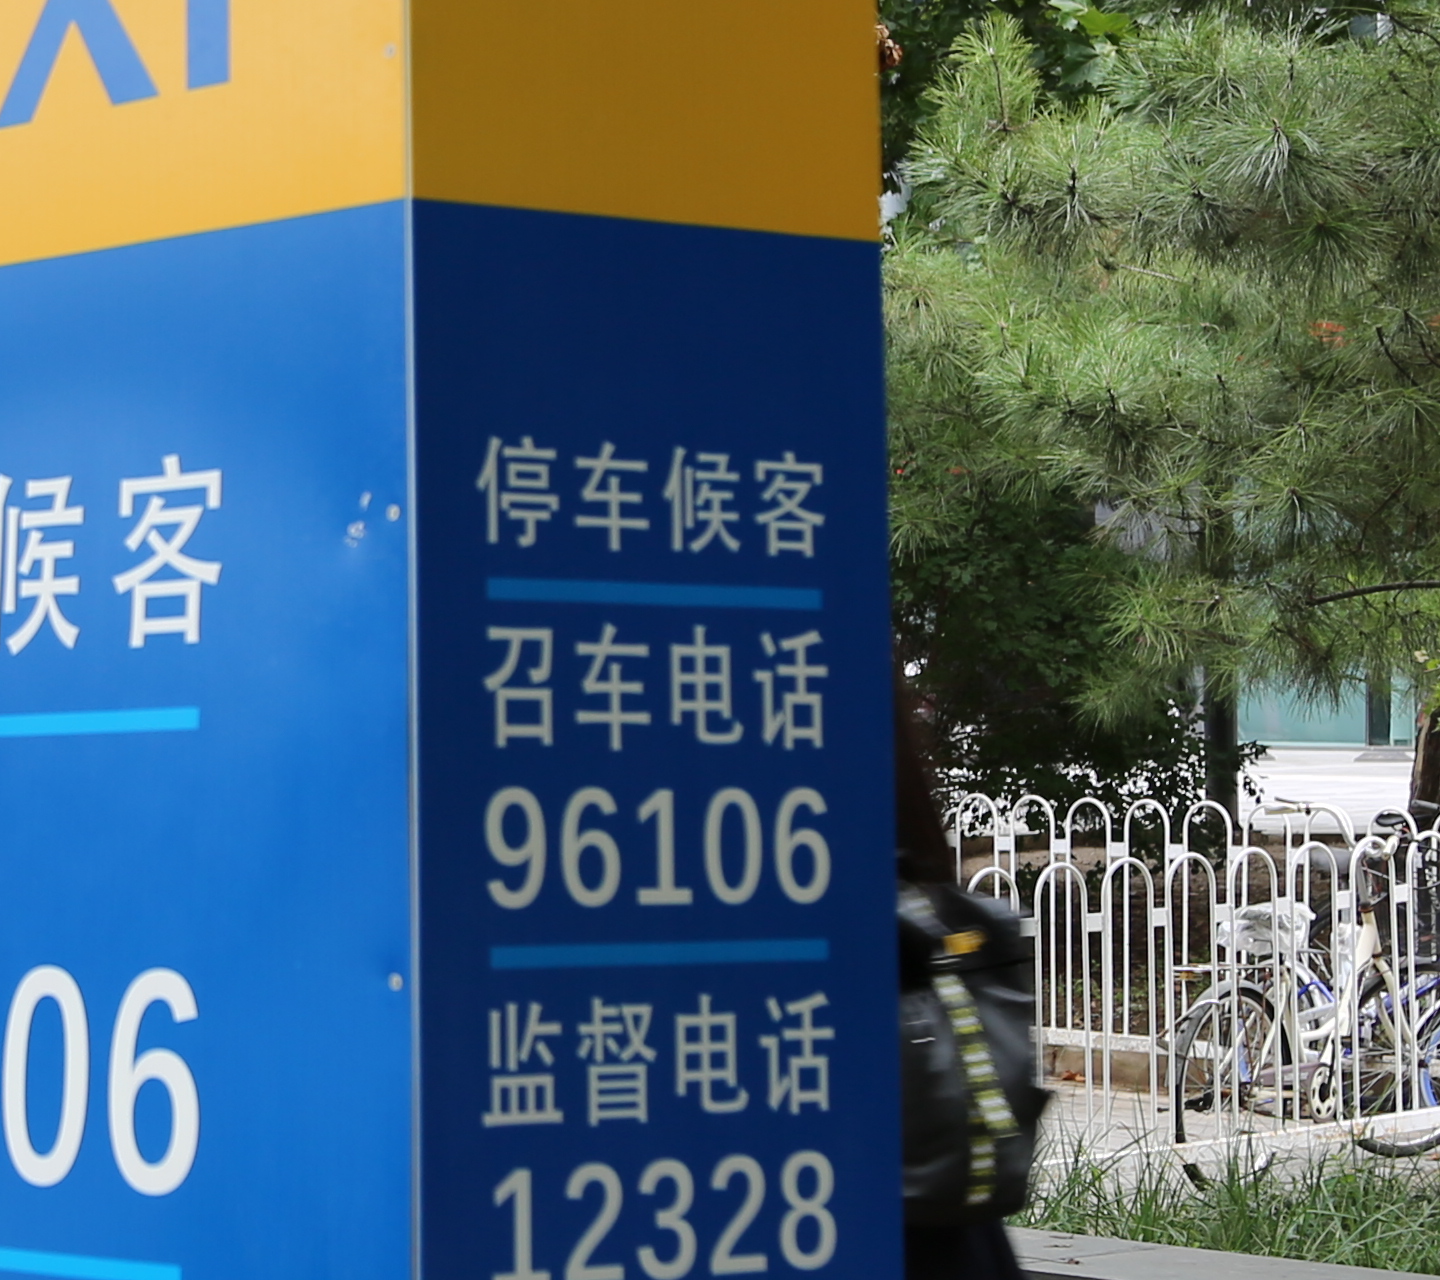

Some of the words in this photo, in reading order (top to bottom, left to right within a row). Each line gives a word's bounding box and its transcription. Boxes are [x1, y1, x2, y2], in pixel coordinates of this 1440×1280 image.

[475, 435, 826, 559] 停车候客
[483, 622, 829, 753] 召车电话
[483, 785, 832, 911] 96106
[482, 991, 836, 1128] 监督电话
